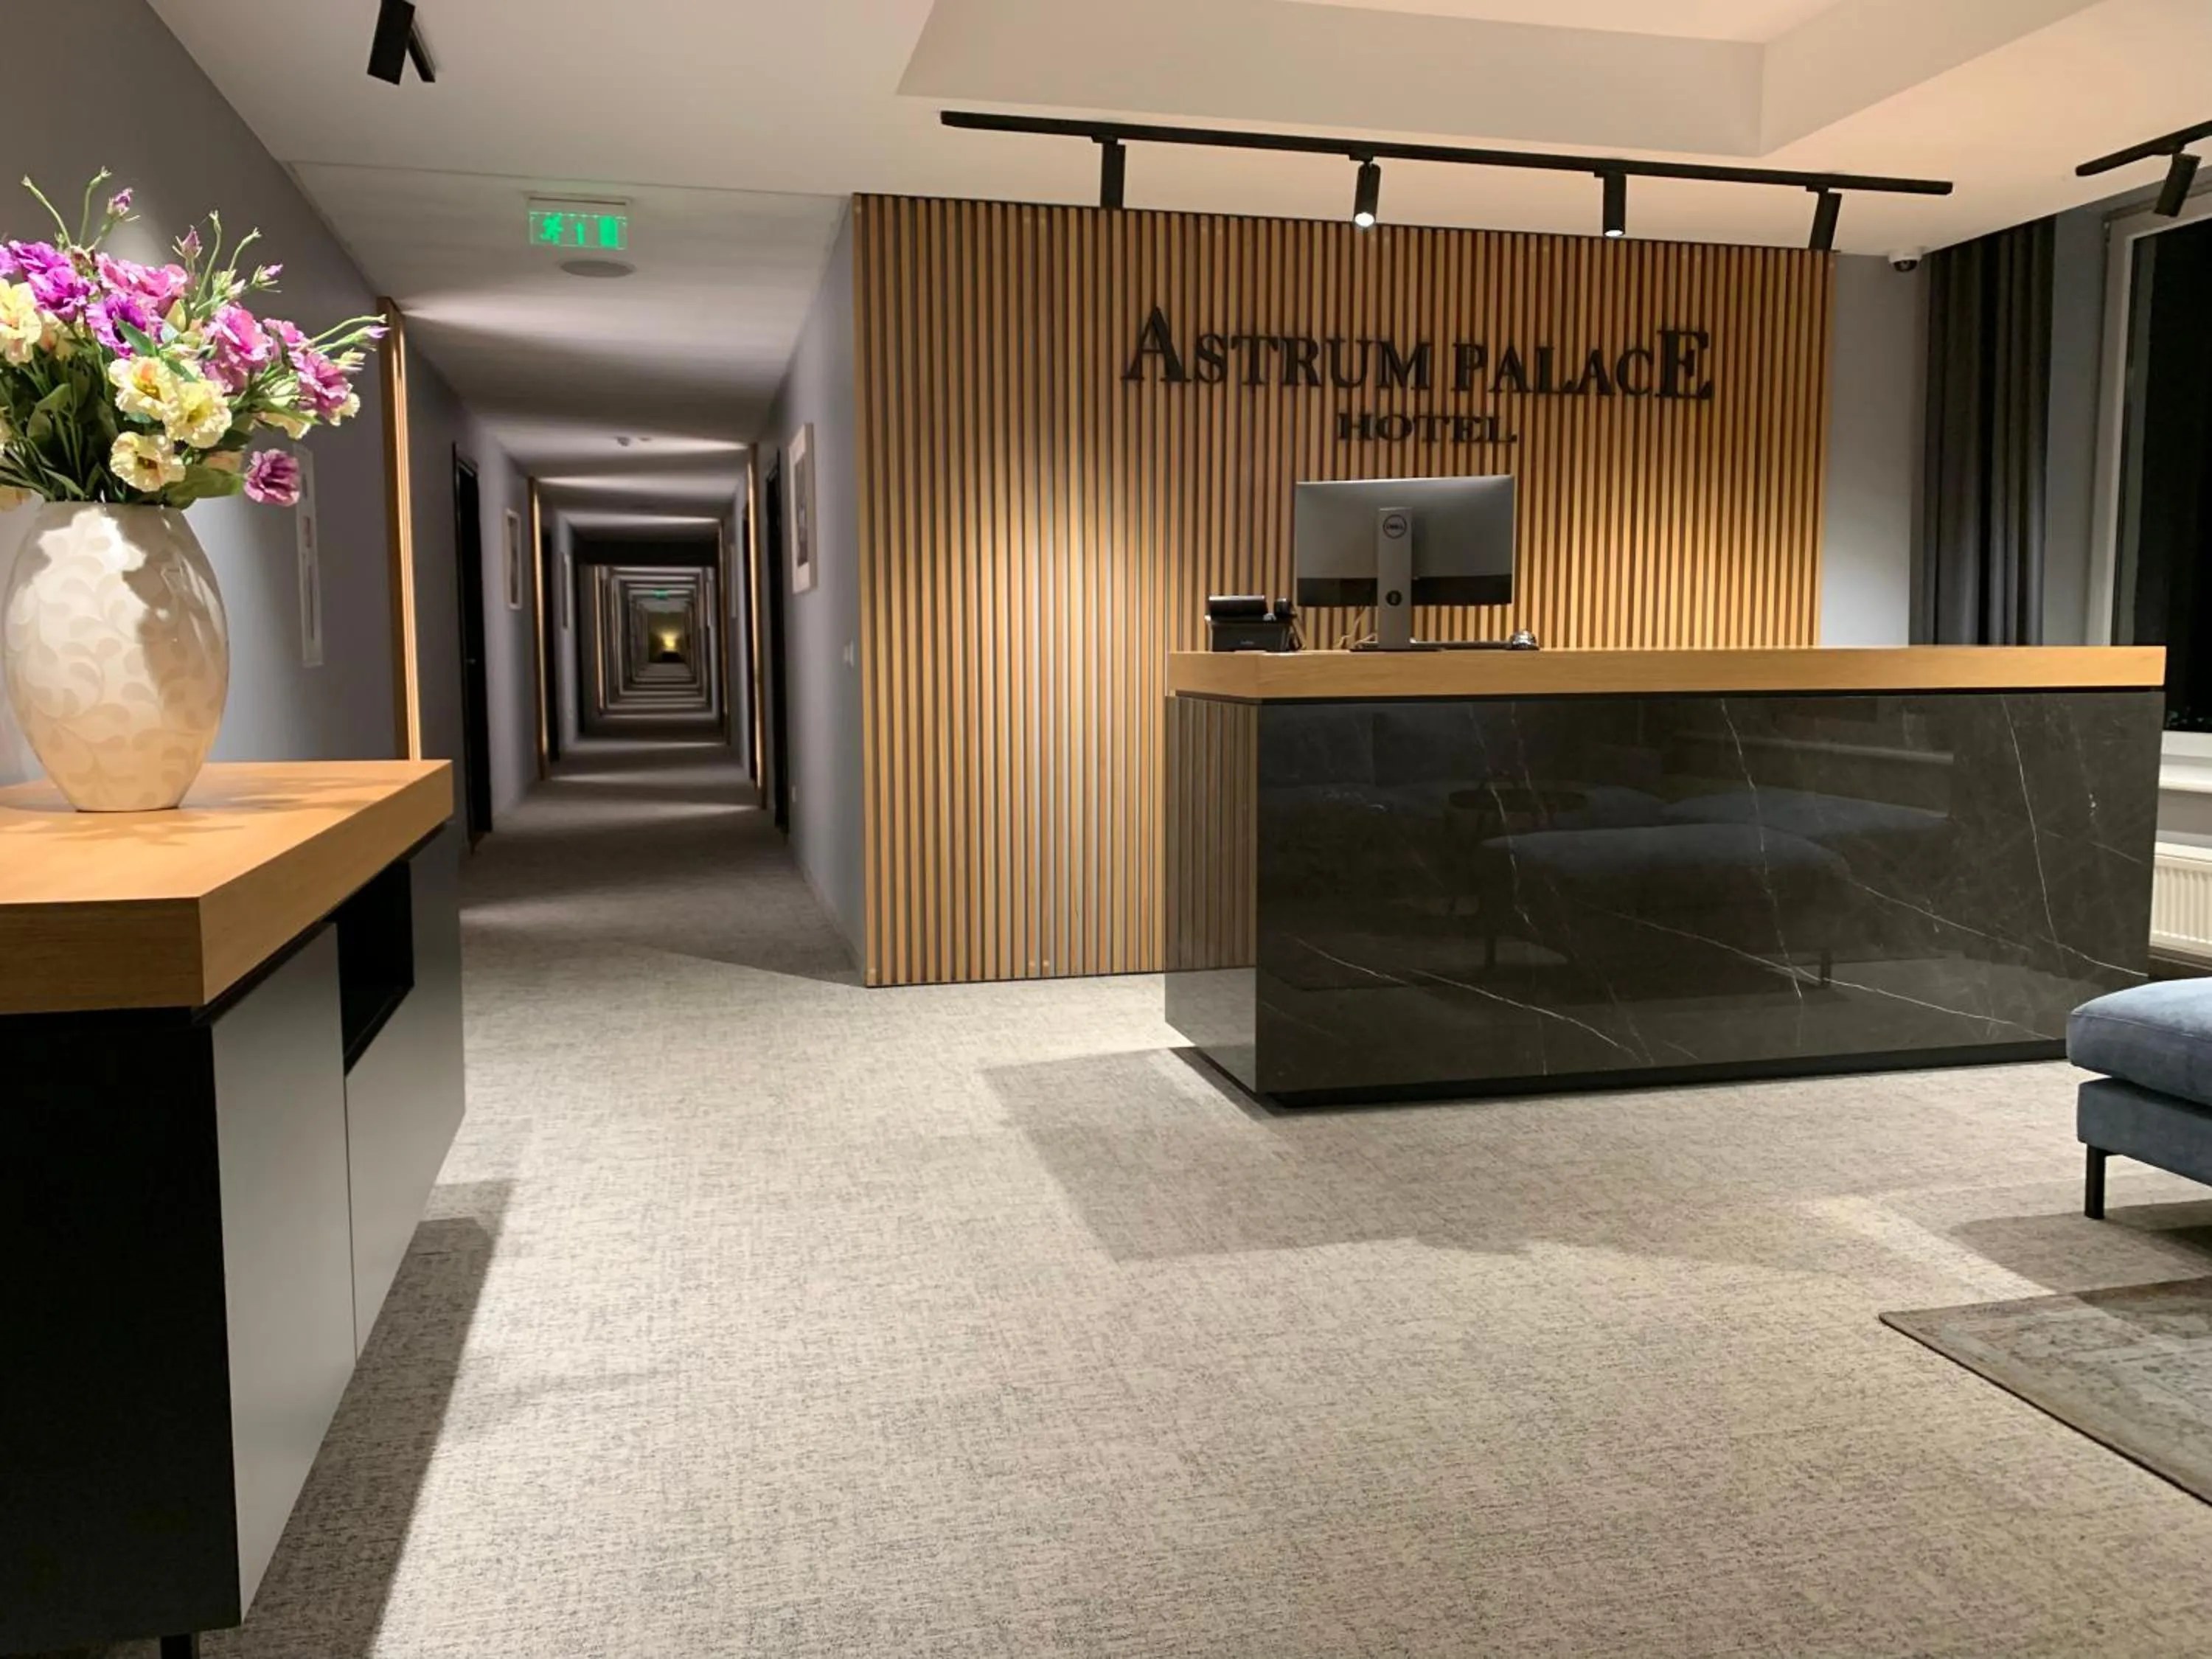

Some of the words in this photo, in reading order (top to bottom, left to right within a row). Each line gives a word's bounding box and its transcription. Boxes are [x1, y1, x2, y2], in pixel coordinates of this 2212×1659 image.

[1120, 306, 1433, 389] ASTRUM
[1450, 329, 1712, 400] PALACE
[1338, 412, 1517, 442] HOTEL
